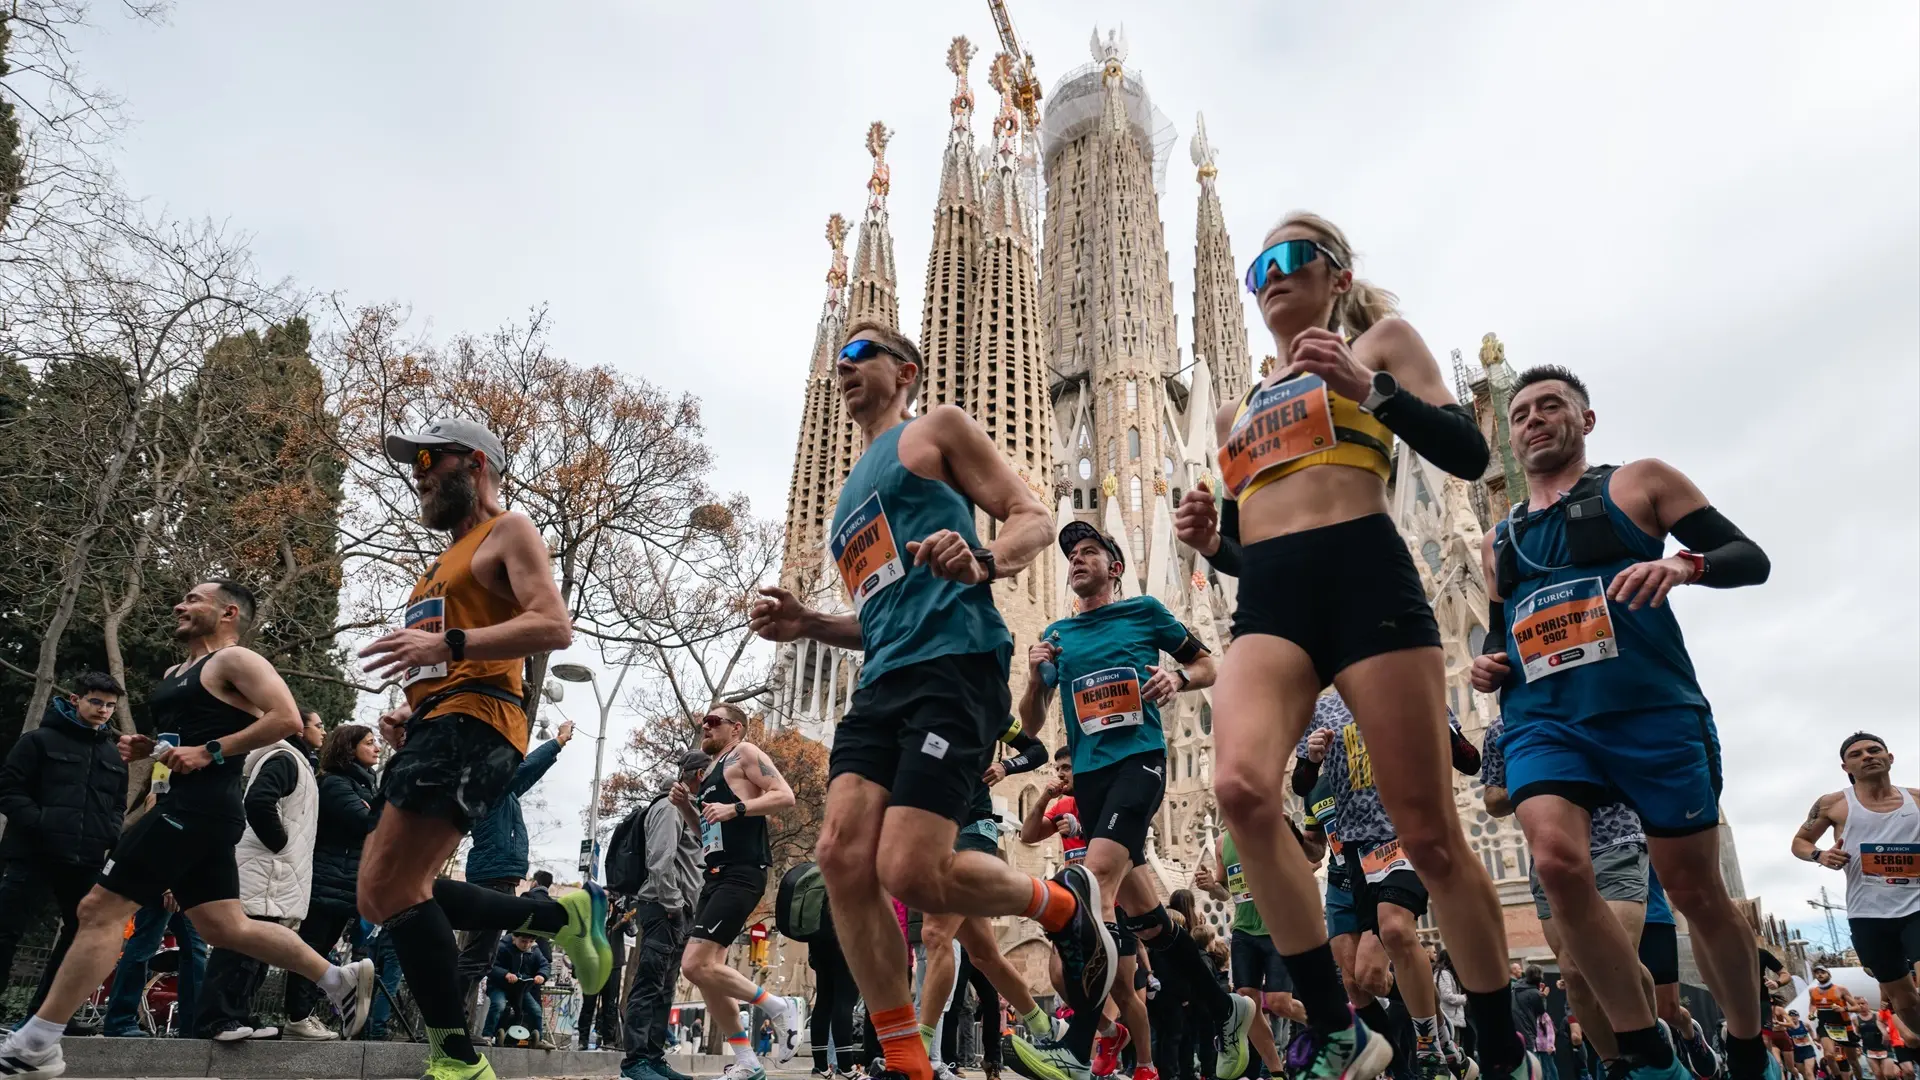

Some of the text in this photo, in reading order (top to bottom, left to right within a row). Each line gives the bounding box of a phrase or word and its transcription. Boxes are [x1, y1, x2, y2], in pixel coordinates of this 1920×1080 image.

[1227, 399, 1308, 462] HEATHER
[845, 514, 866, 537] ZURICH
[1537, 589, 1574, 606] ZURICH
[1535, 605, 1607, 636] CHRISTOPHE
[1543, 629, 1568, 645] 9902
[1096, 673, 1120, 683] ZURICH
[1082, 683, 1130, 705] HENDRIK
[1874, 855, 1914, 865] SERGIO
